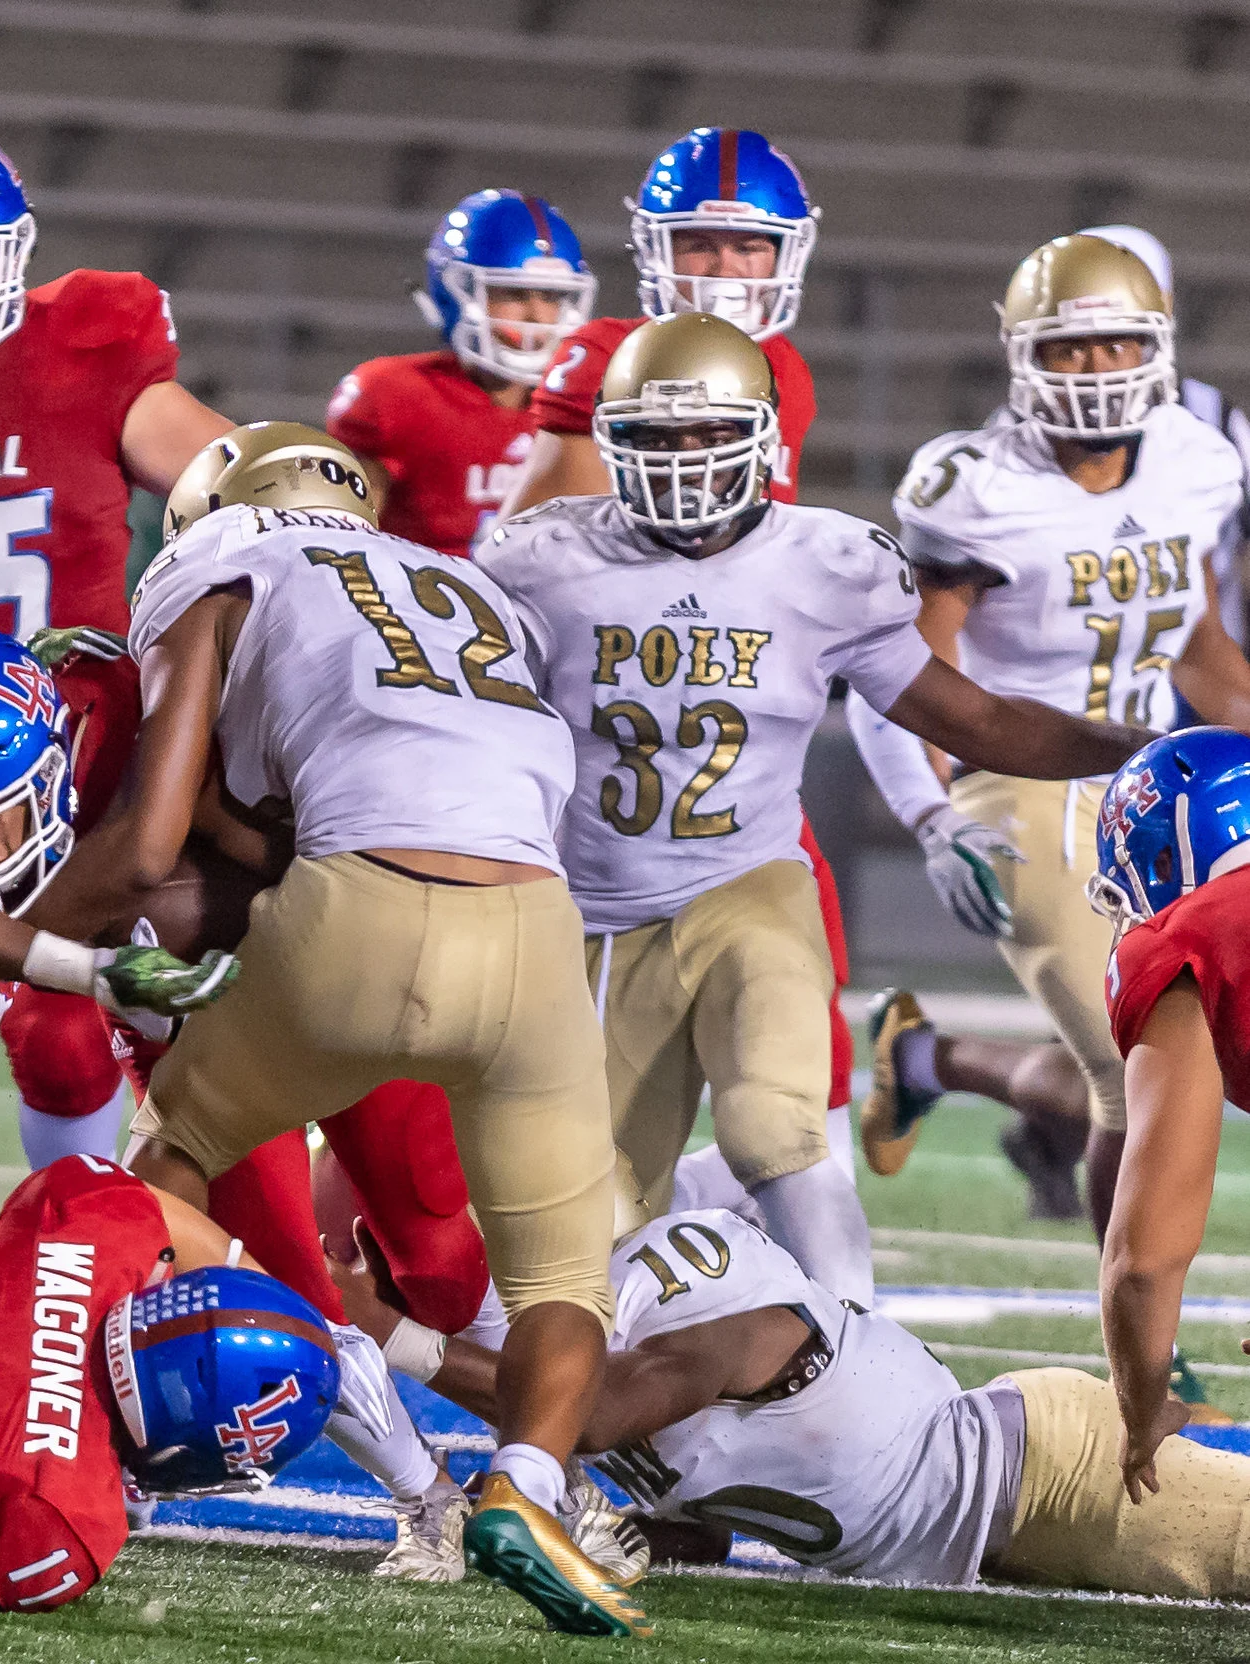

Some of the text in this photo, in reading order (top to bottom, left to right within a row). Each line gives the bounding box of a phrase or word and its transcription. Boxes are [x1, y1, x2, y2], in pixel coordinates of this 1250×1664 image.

[1064, 534, 1191, 607] POLY
[301, 546, 561, 720] 12
[591, 624, 773, 688] POLY
[1085, 603, 1187, 727] 15
[590, 700, 749, 840] 32
[626, 1222, 730, 1306] 10
[23, 1241, 96, 1460] WAGONER
[214, 1374, 302, 1473] LA
[7, 1547, 81, 1607] 17
